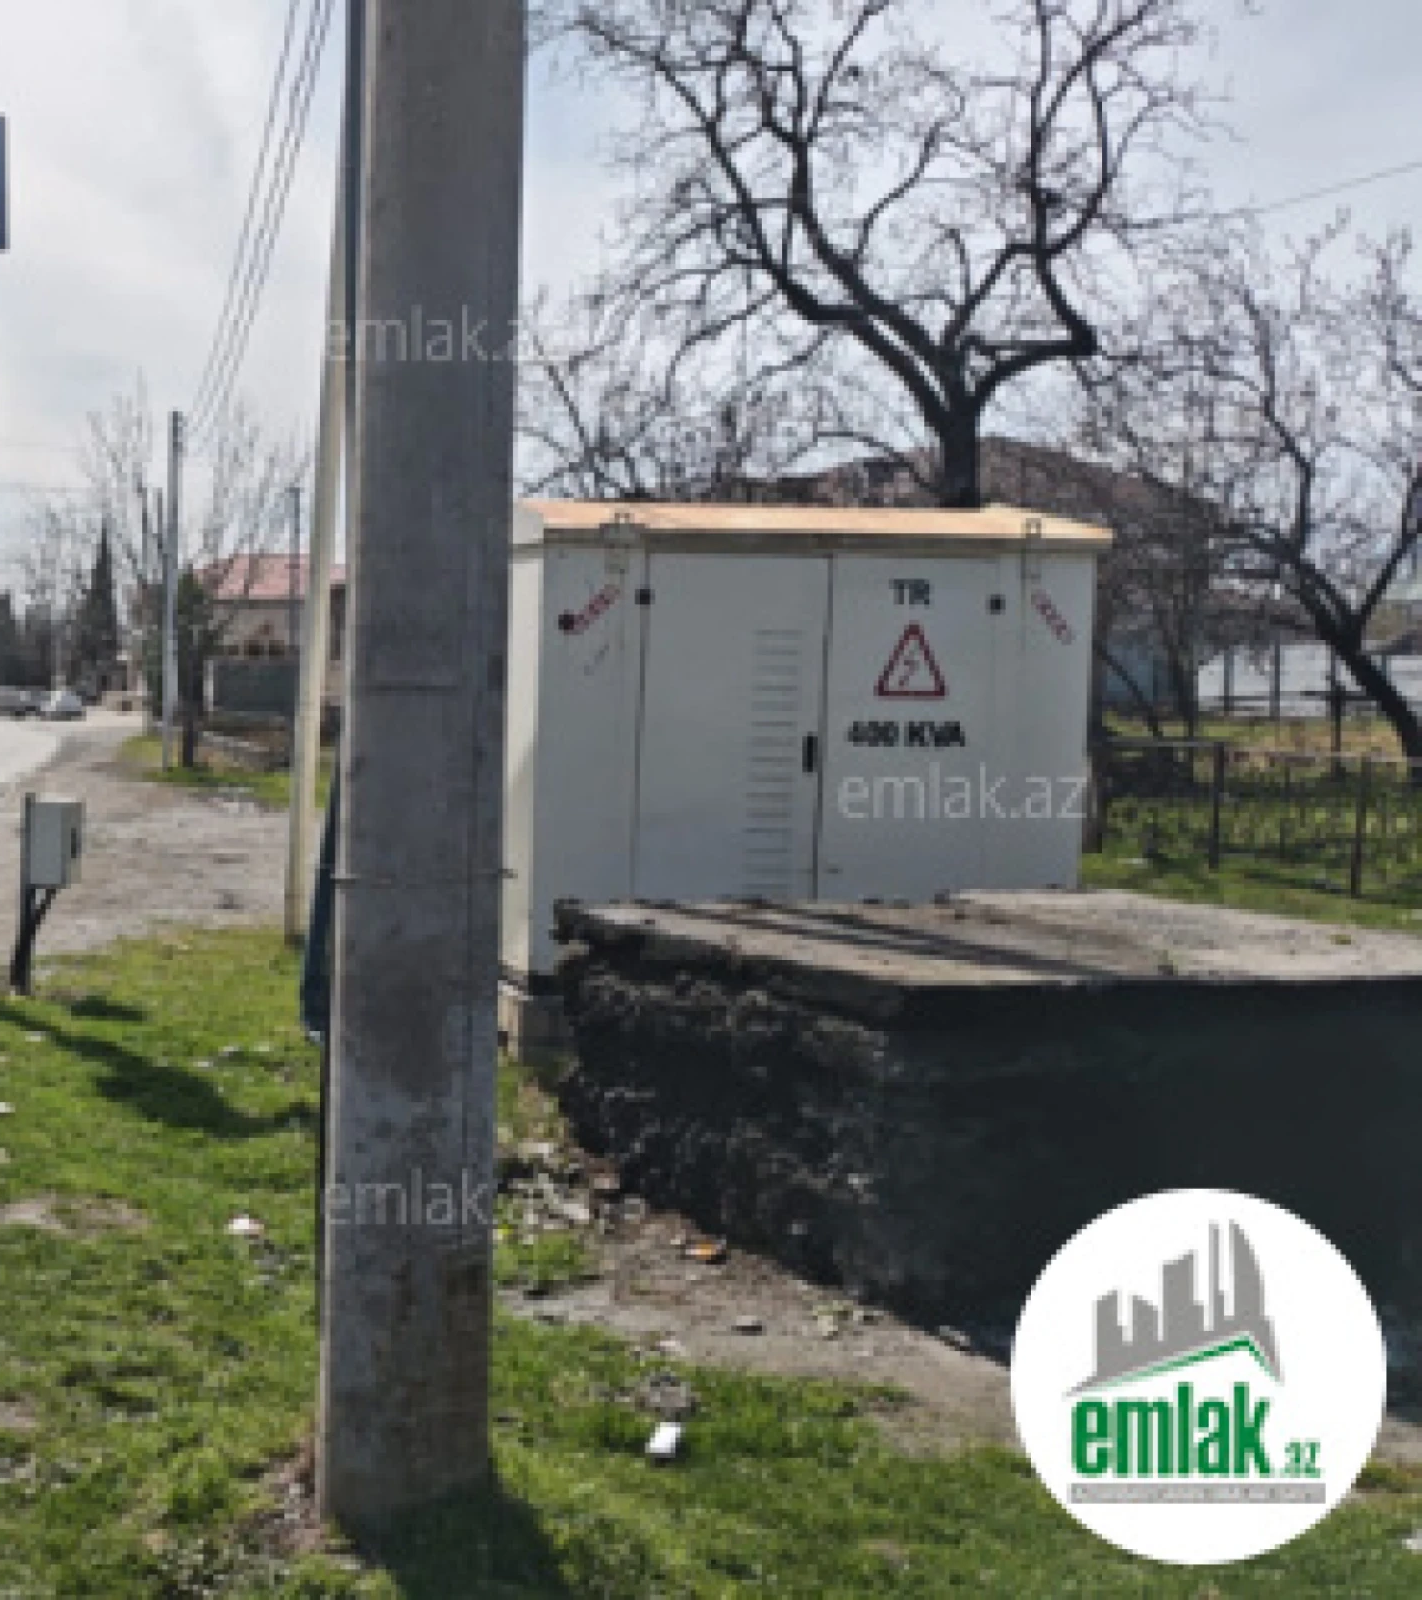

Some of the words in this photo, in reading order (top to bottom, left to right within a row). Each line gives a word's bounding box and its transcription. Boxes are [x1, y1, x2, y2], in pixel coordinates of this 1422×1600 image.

[889, 578, 931, 607] TR
[846, 720, 899, 748] 400
[903, 720, 966, 748] KVA
